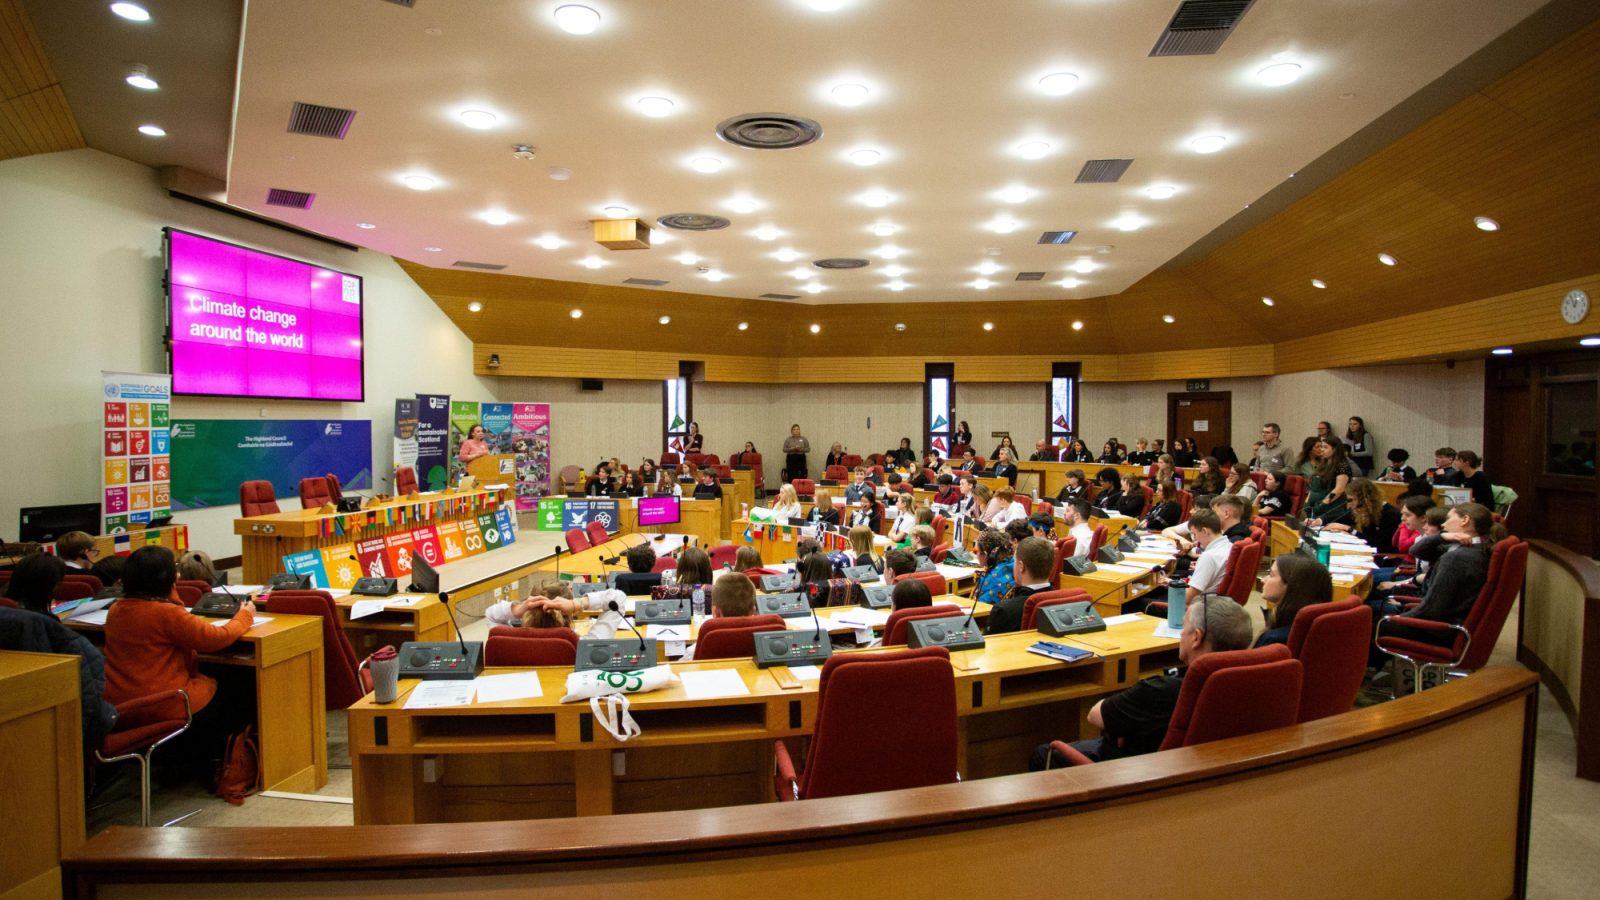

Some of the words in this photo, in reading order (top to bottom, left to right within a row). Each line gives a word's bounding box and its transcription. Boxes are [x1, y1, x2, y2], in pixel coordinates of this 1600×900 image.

[190, 294, 246, 319] Climate
[249, 304, 297, 329] change
[190, 322, 242, 342] around
[245, 326, 267, 345] the
[270, 332, 304, 349] world
[483, 413, 512, 421] Connected
[513, 413, 547, 421] Ambitious
[590, 502, 596, 510] 17
[357, 543, 363, 554] 8
